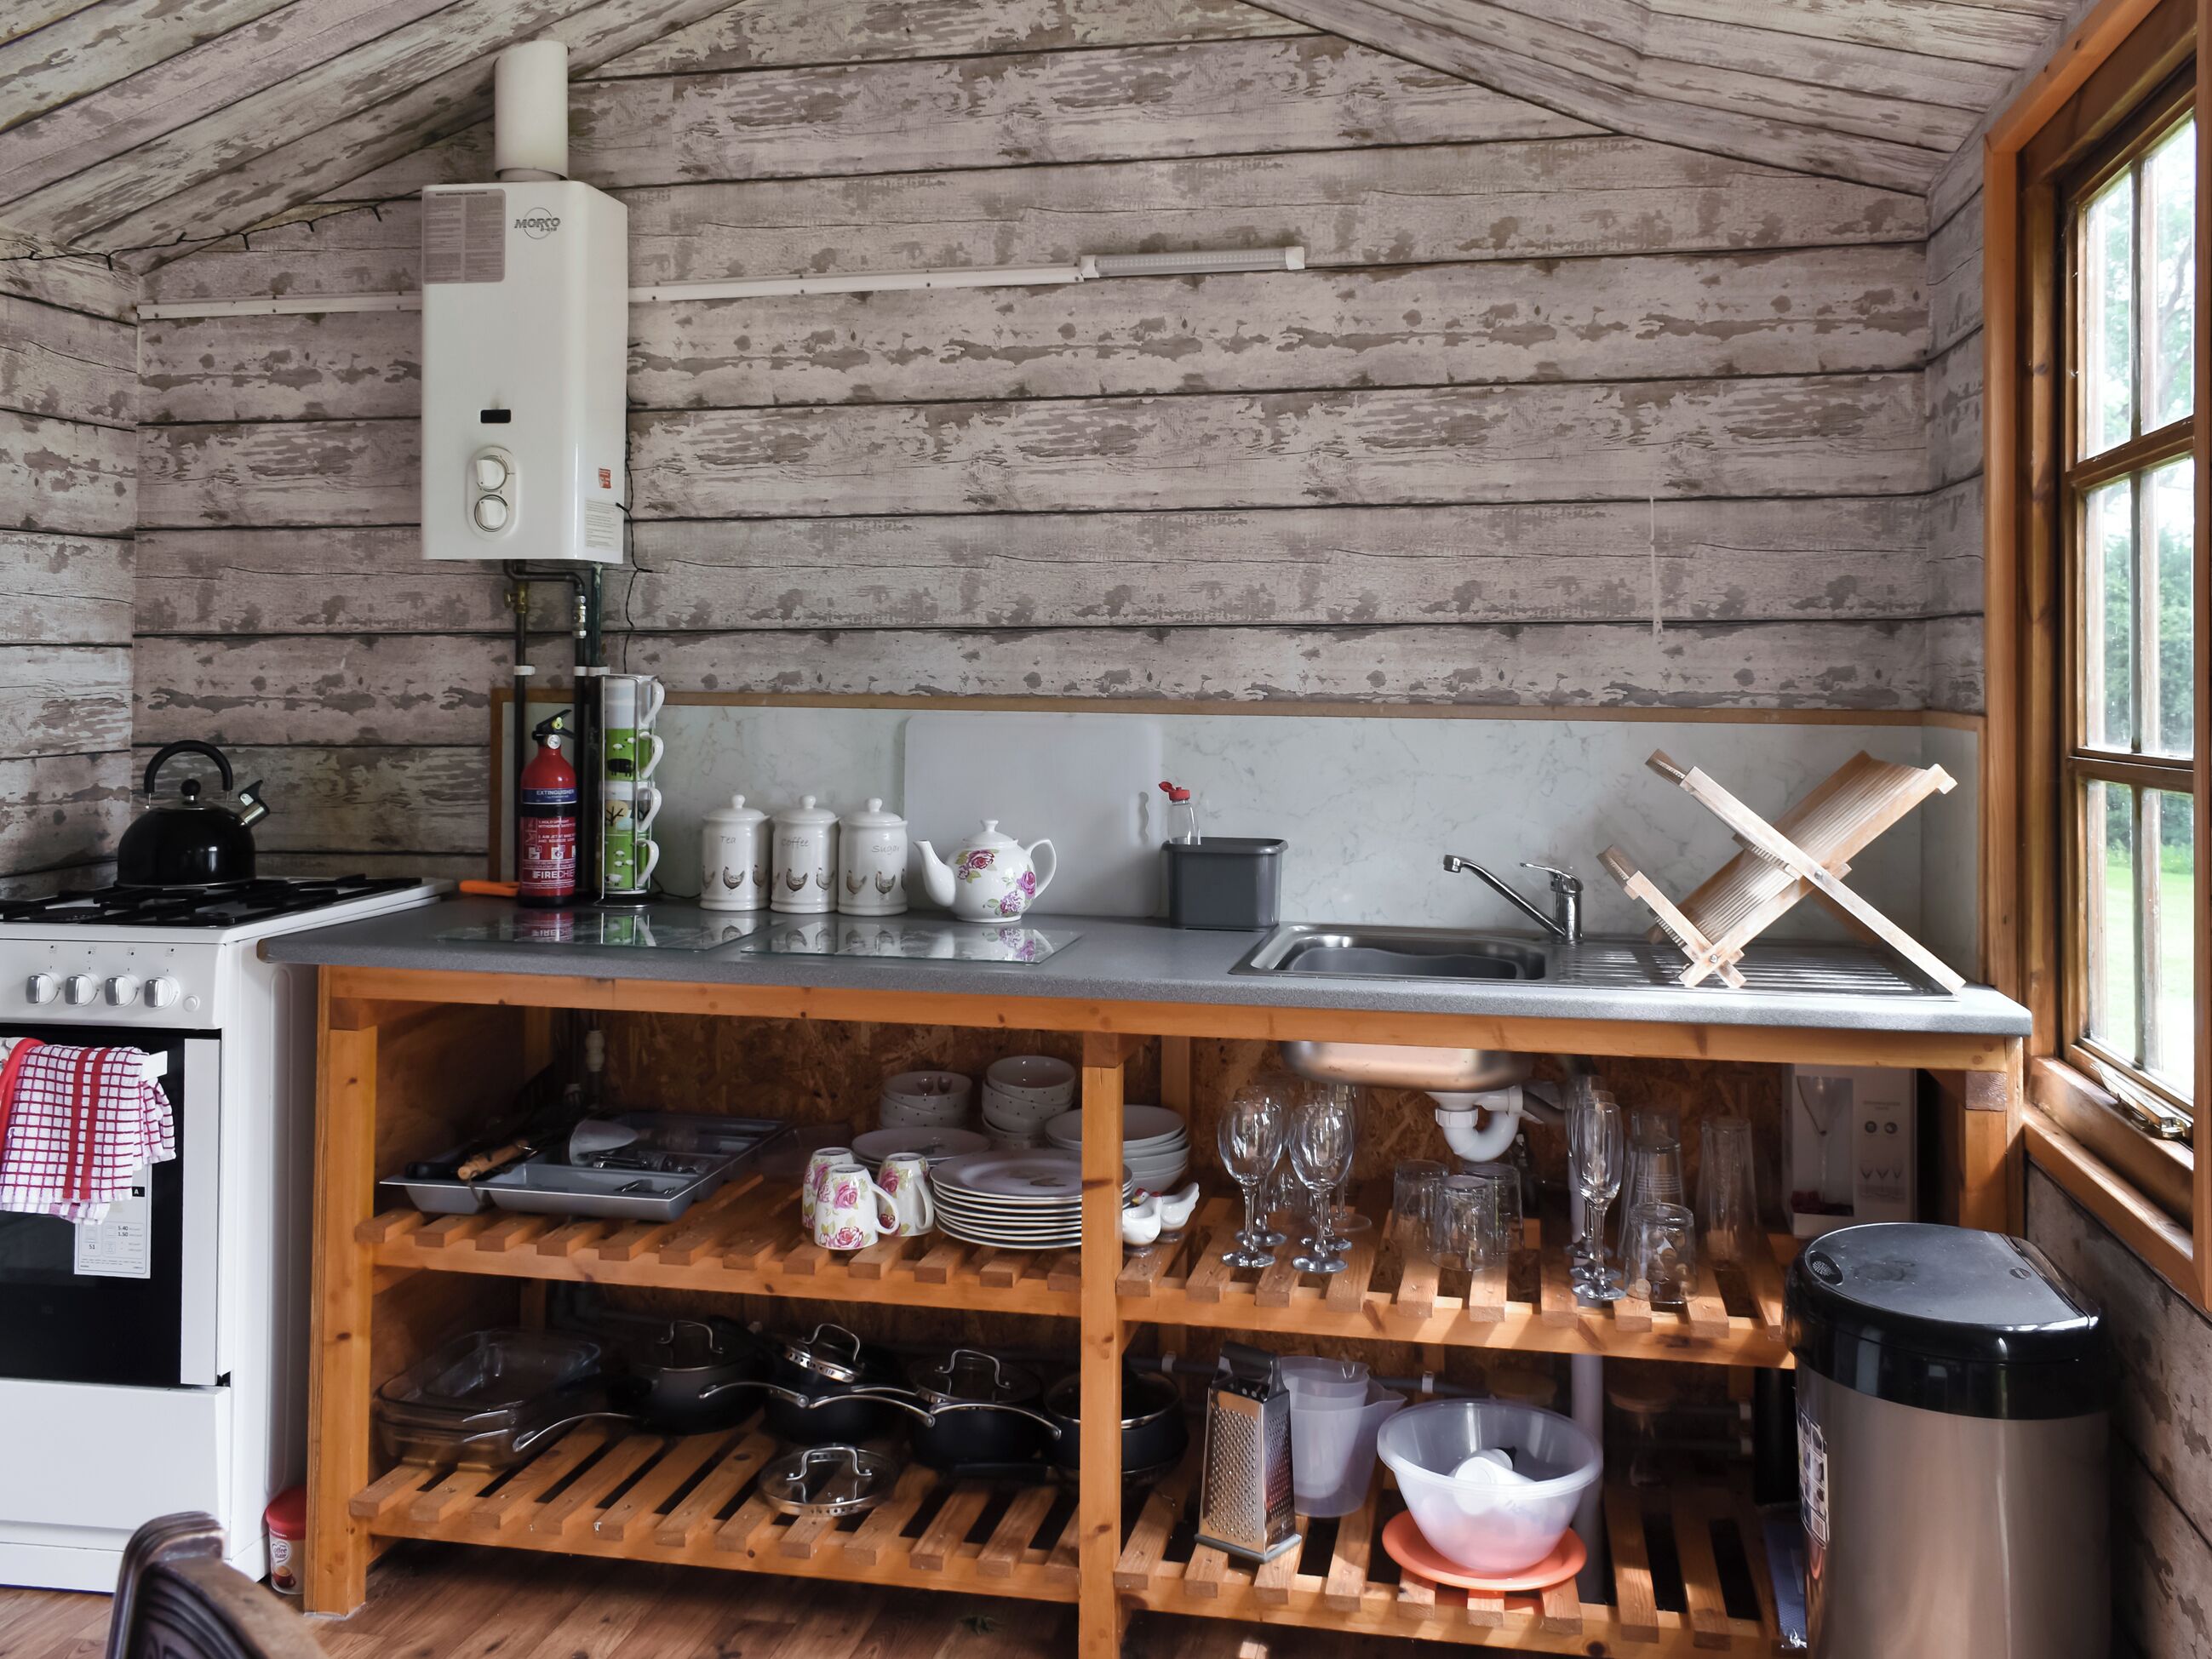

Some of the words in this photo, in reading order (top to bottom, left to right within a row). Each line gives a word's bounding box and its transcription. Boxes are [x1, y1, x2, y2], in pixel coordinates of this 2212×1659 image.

[514, 218, 561, 228] MORCO
[720, 836, 736, 844] Tea
[871, 844, 900, 855] Sugar
